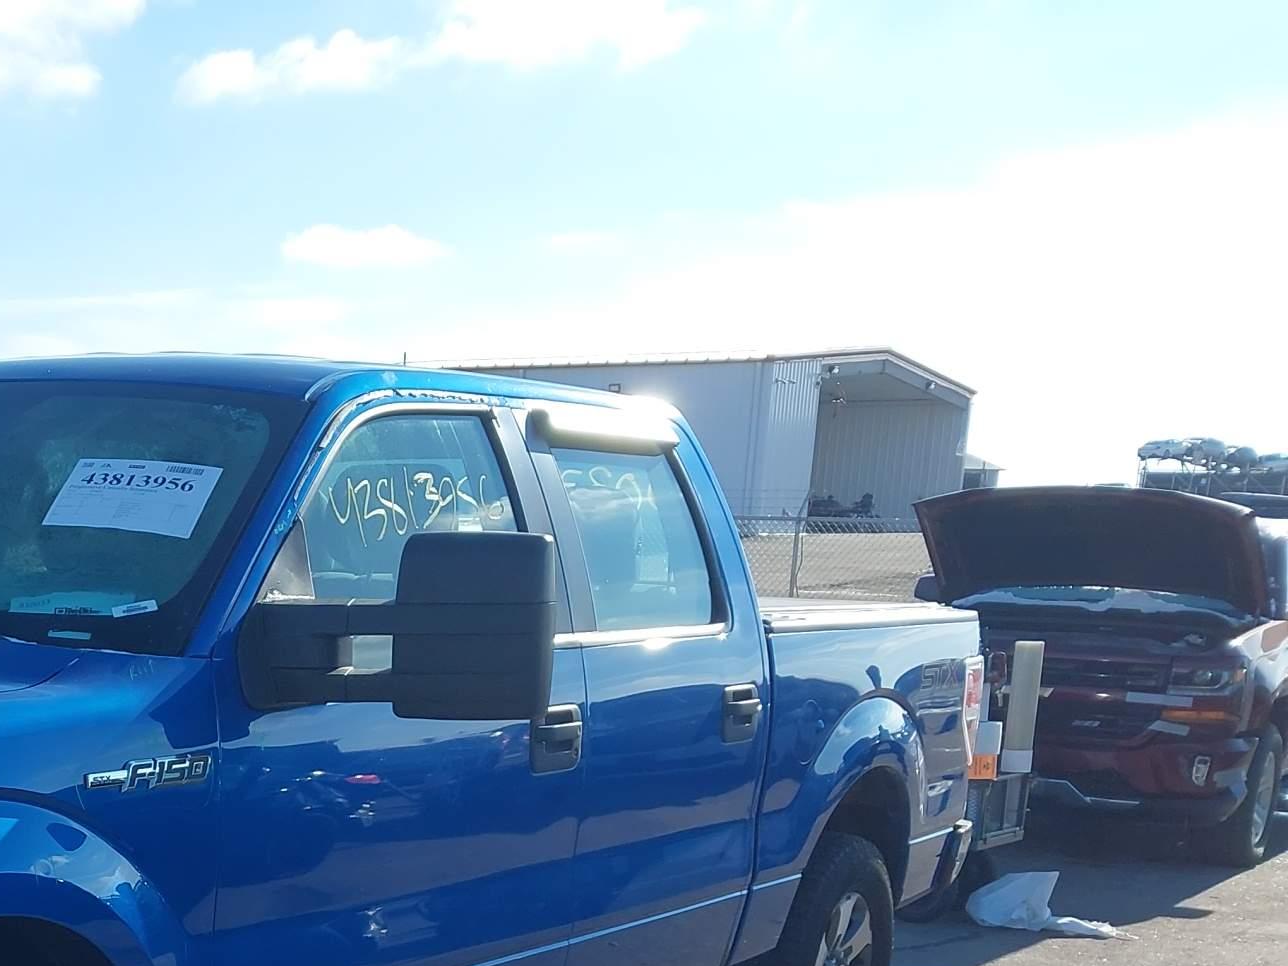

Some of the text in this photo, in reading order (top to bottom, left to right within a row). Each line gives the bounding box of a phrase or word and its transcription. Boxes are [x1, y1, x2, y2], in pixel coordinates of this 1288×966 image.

[81, 472, 197, 493] 43813956
[328, 466, 505, 548] 43813956
[921, 660, 960, 689] STX
[92, 757, 211, 793] STX F-150
